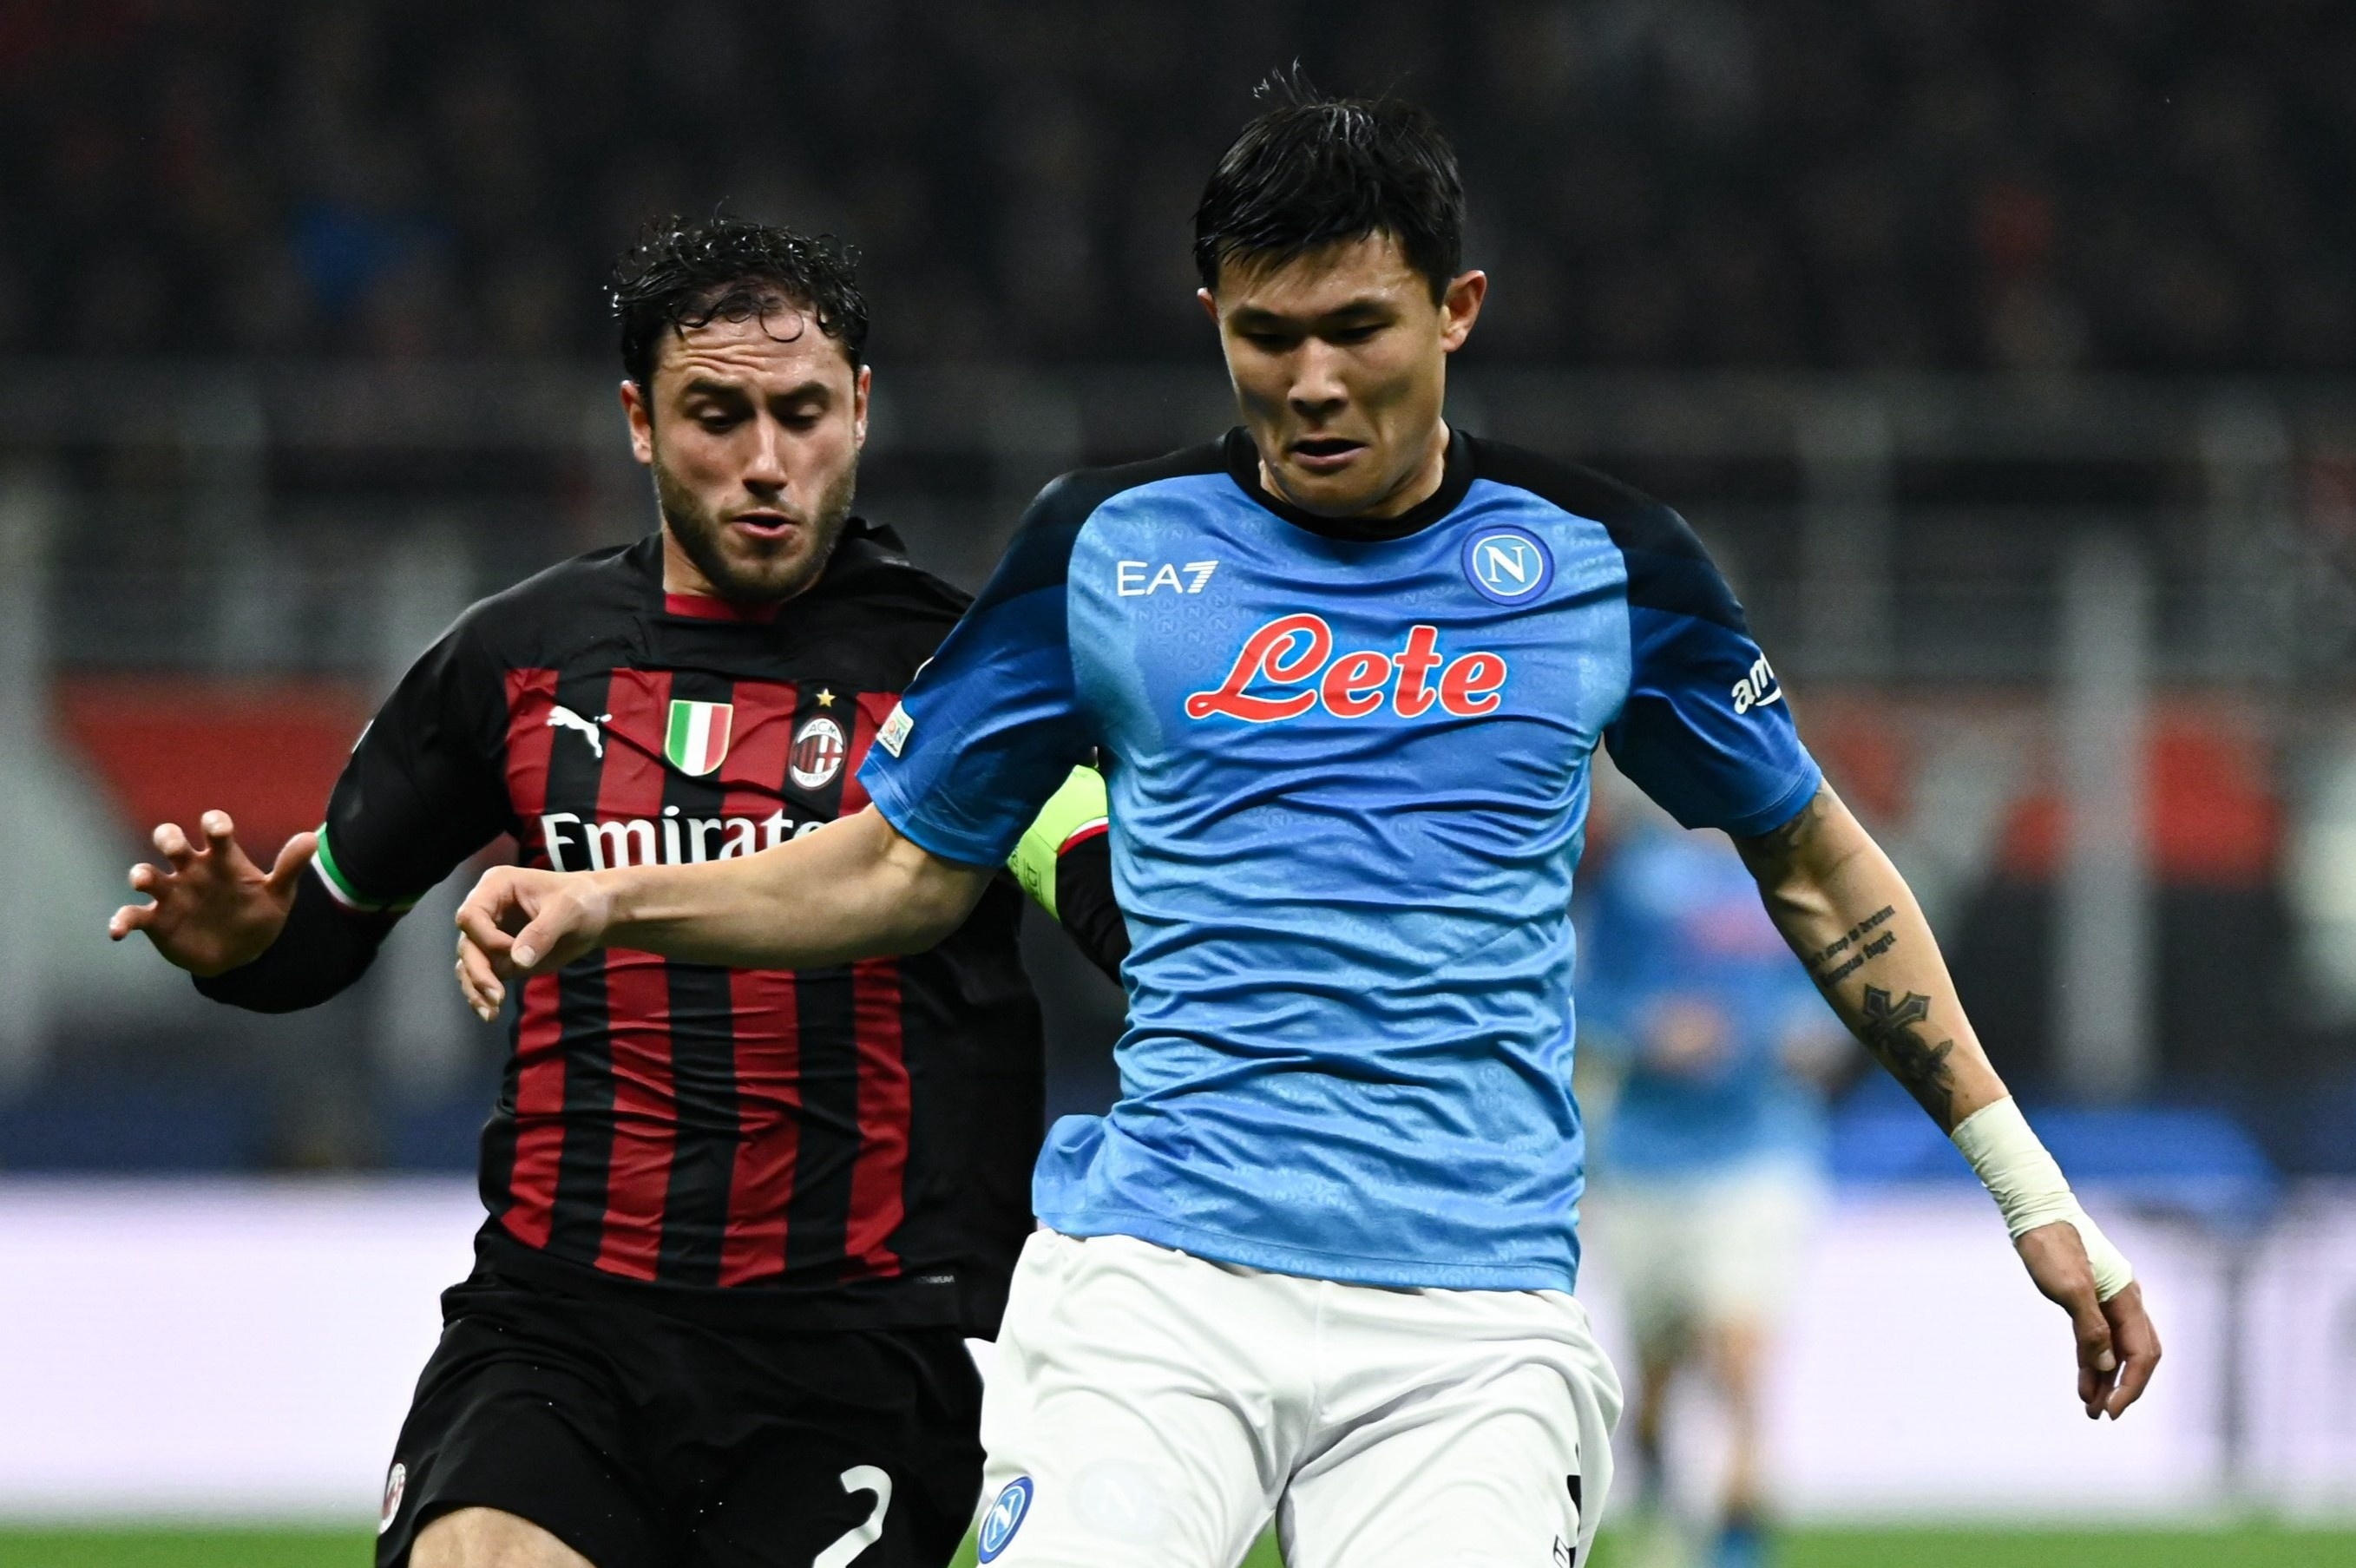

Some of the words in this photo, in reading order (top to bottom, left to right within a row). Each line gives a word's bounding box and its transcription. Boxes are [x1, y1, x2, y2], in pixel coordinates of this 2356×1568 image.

[1117, 560, 1219, 597] EA7
[1487, 546, 1530, 584] N
[1185, 613, 1508, 723] Lete
[806, 720, 838, 736] ACM
[811, 1464, 892, 1568] 2
[988, 1493, 1020, 1544] N
